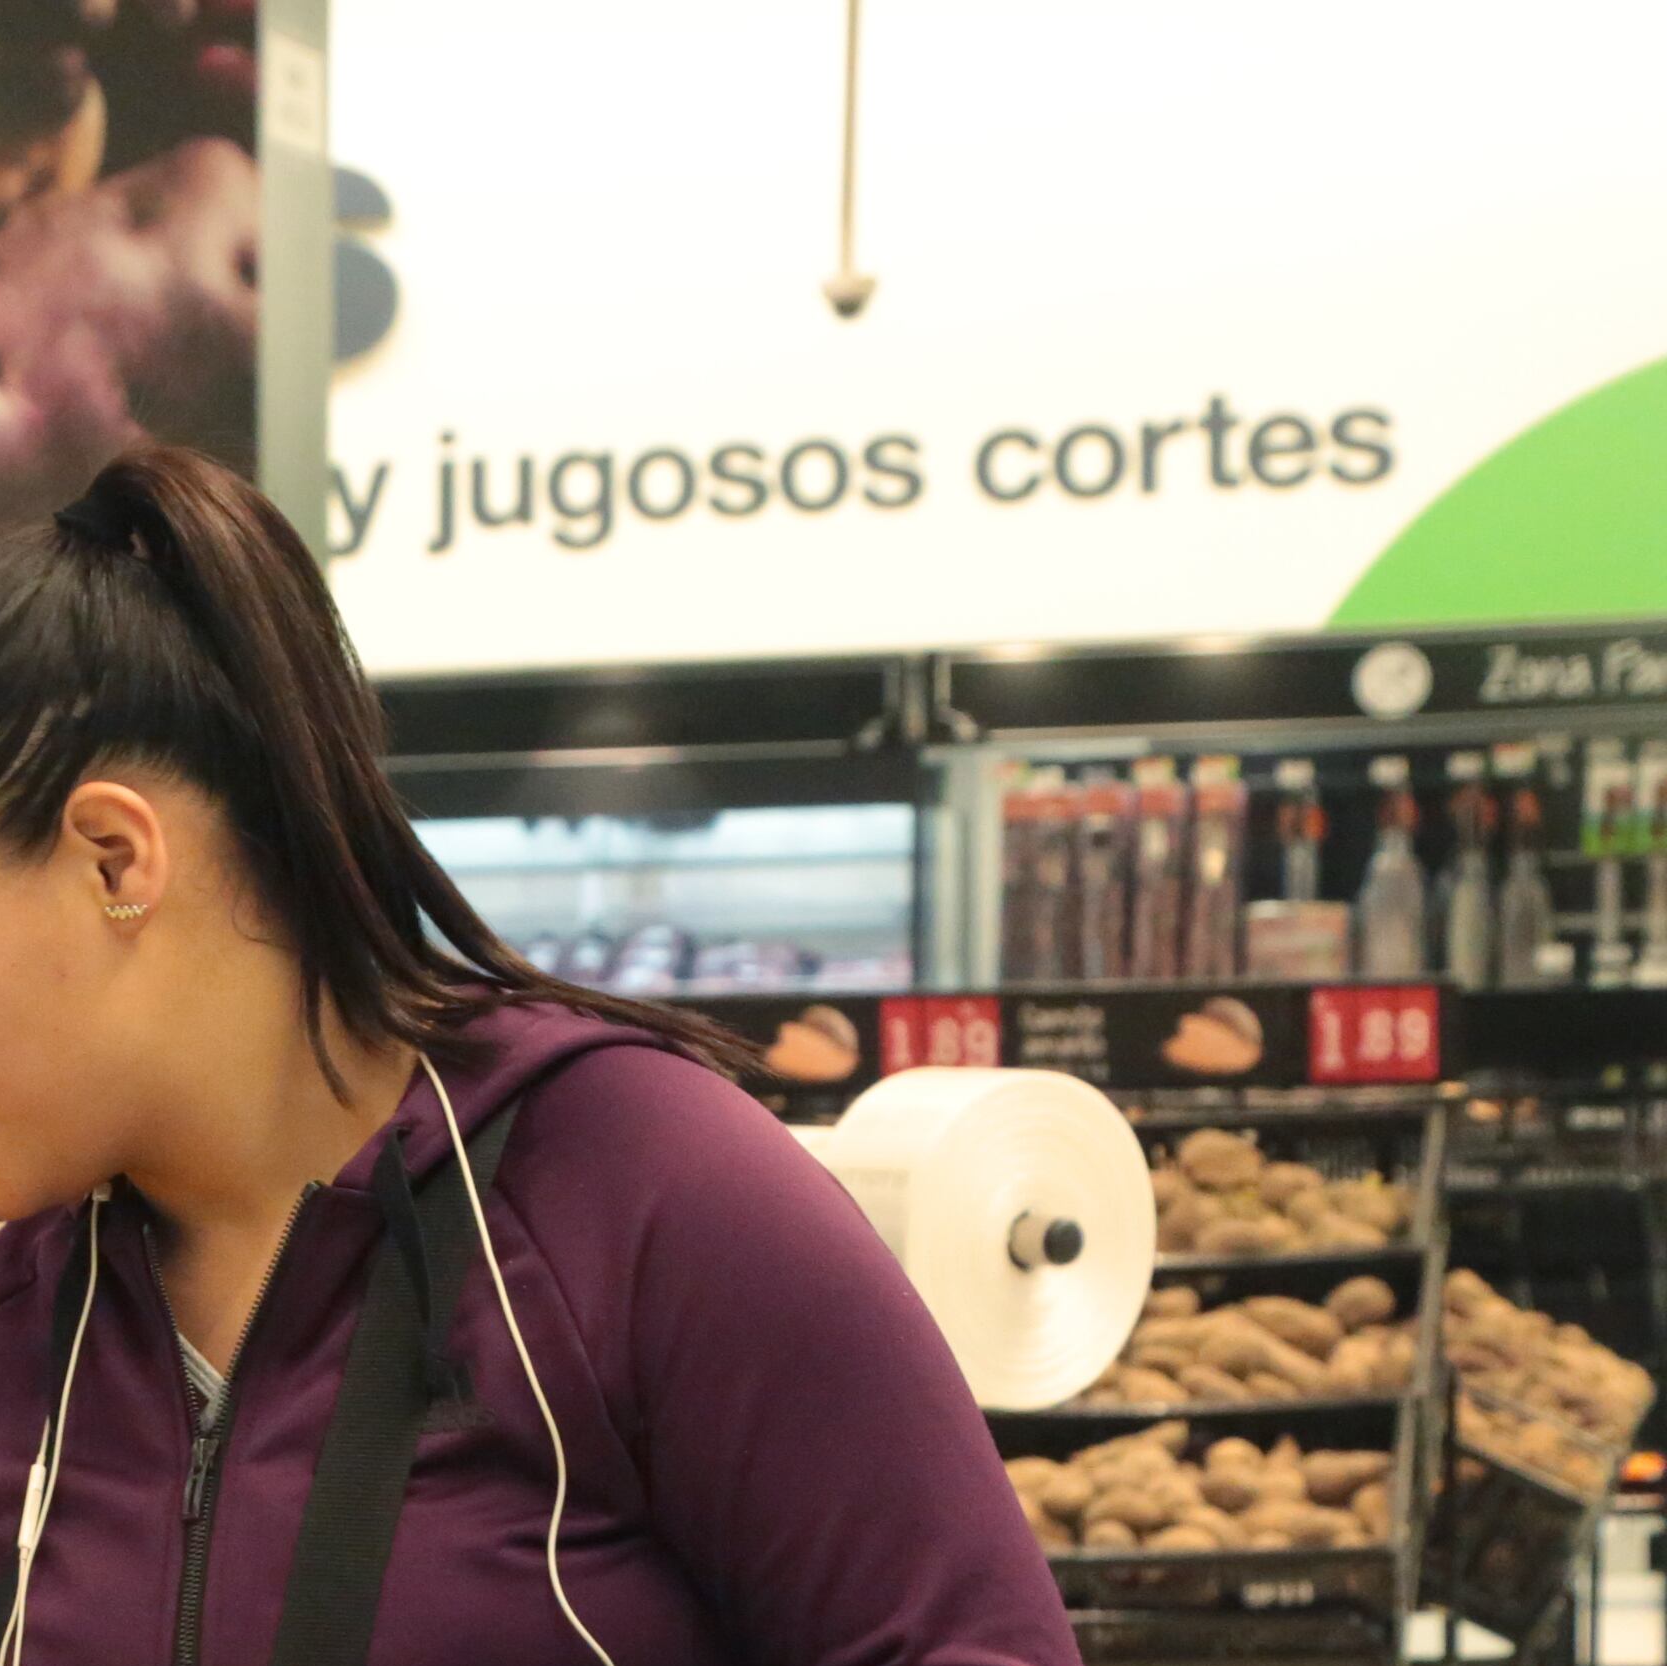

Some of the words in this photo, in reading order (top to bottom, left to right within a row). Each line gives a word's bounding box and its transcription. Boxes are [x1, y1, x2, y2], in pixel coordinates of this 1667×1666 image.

[328, 460, 387, 558] y
[429, 428, 923, 551] jugosos
[976, 396, 1394, 503] cortes
